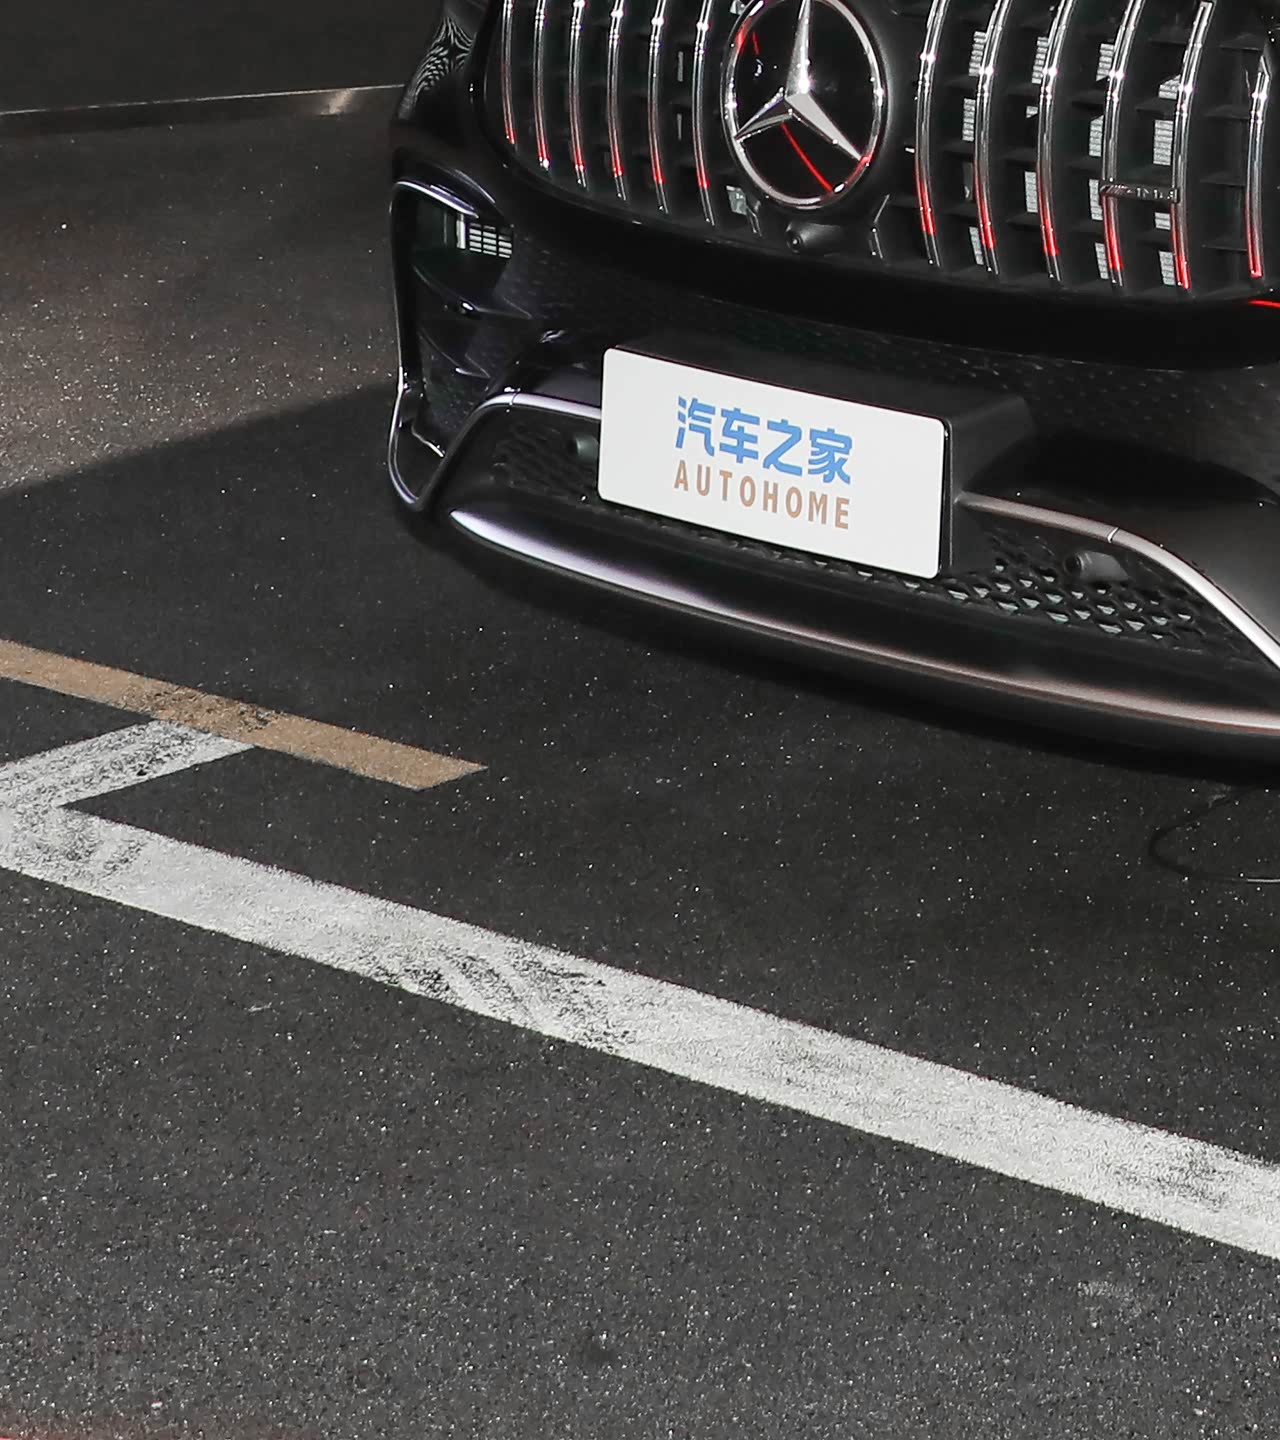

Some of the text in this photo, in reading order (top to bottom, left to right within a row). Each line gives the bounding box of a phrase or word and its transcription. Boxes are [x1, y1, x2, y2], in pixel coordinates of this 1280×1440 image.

[675, 395, 853, 485] 汽车之家
[674, 460, 850, 530] AUTOHOME
